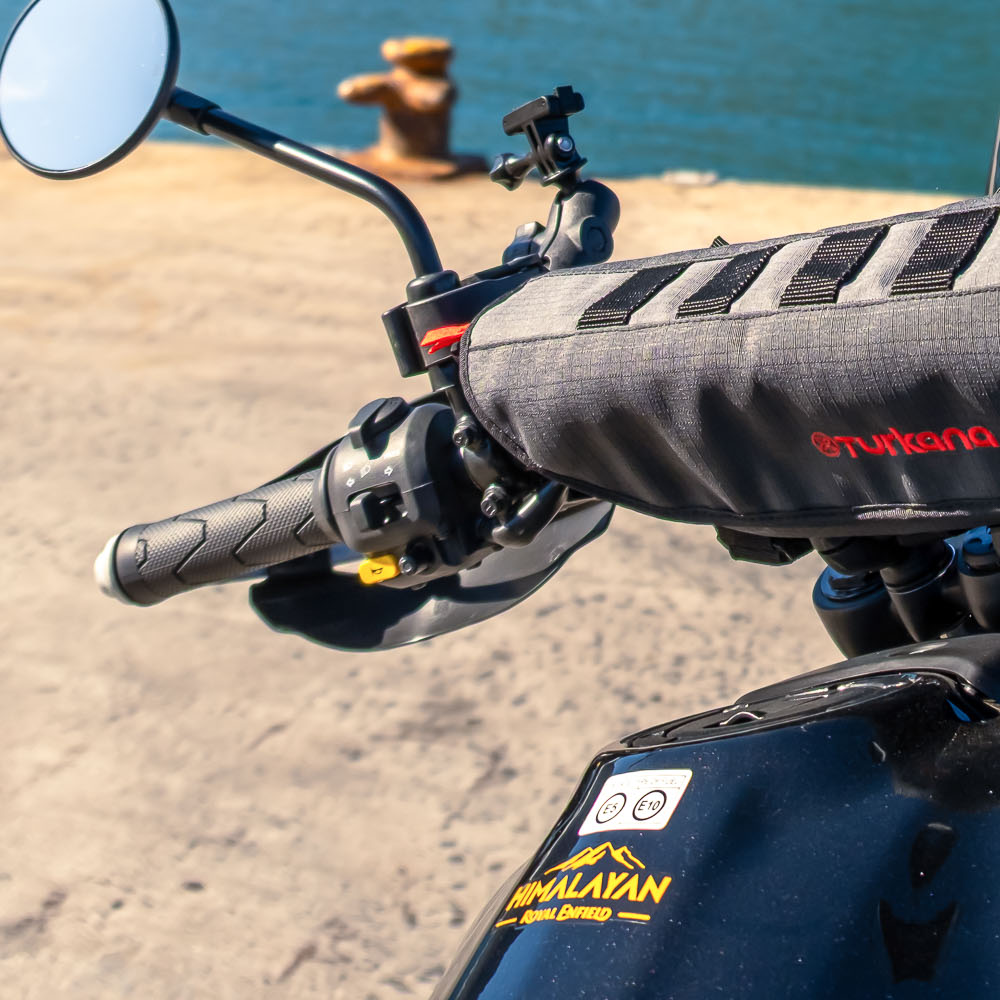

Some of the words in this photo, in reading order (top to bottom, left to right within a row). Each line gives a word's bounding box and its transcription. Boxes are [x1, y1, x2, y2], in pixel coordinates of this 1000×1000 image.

[834, 426, 1000, 458] Turkana
[602, 803, 618, 815] E5
[637, 800, 661, 811] E10
[505, 871, 672, 912] HIMALAYAN
[555, 903, 612, 922] ENFIELD
